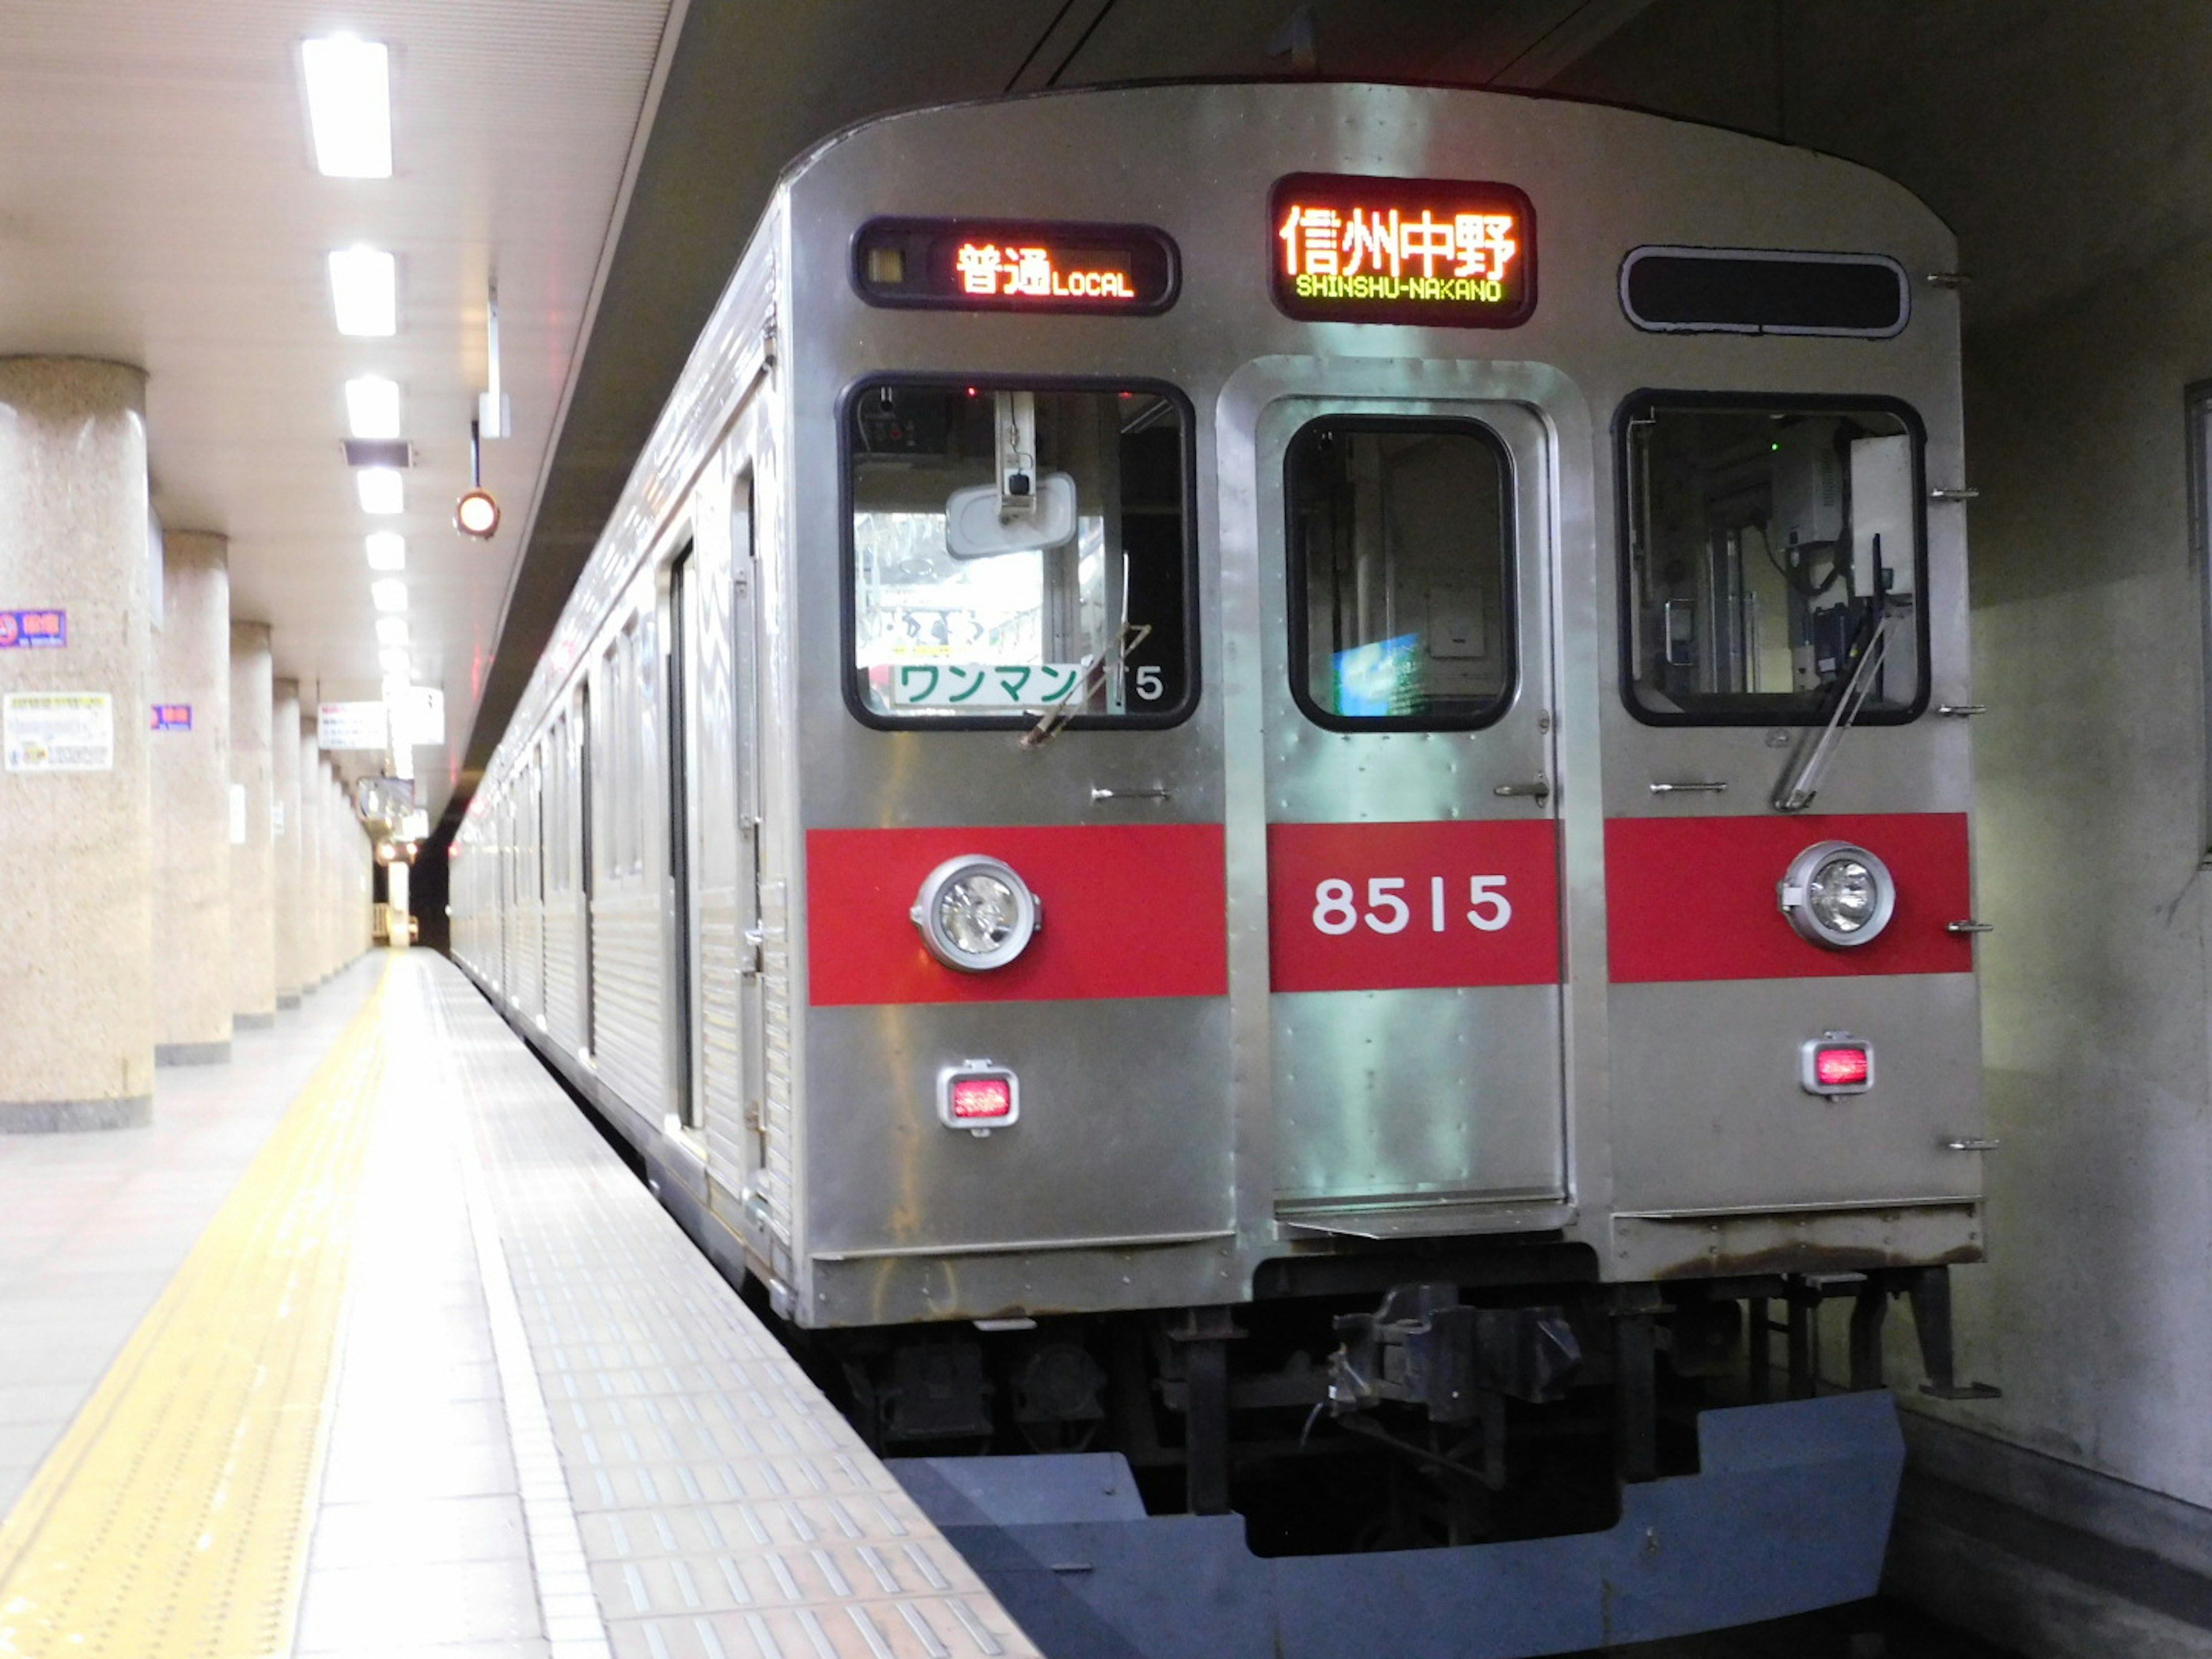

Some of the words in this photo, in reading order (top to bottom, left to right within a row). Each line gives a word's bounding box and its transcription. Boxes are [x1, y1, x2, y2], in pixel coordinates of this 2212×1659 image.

[956, 243, 1051, 295] 普通
[1052, 271, 1134, 297] LOCAL
[1279, 205, 1516, 281] 信州中野
[1296, 274, 1502, 302] SHINSHU-NAKANO
[901, 665, 1077, 702] ワンマン
[1312, 874, 1512, 935] 8515
